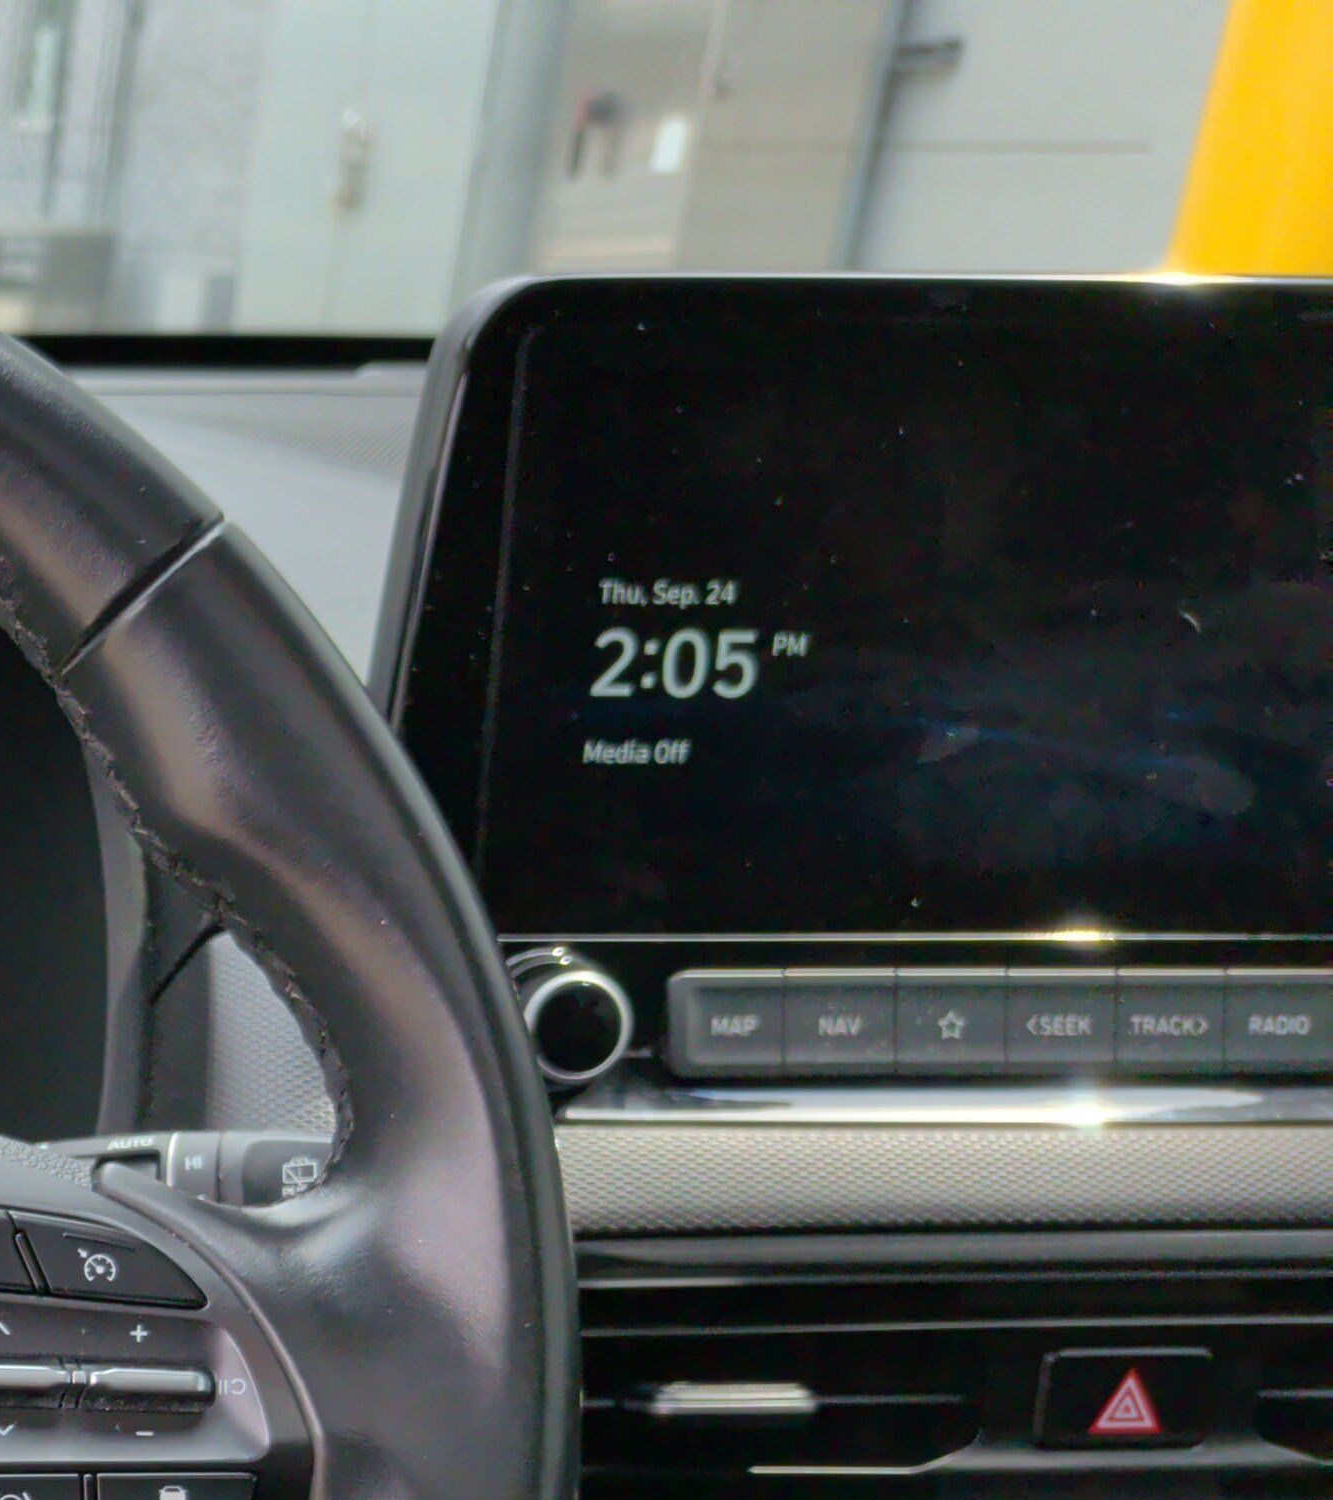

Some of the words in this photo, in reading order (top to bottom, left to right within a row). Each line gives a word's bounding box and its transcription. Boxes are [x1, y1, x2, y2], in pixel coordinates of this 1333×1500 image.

[652, 577, 701, 609] Sep.
[706, 578, 738, 605] 24
[590, 626, 760, 699] 2:05
[772, 632, 810, 657] PM
[583, 738, 651, 765] Media
[653, 738, 692, 765] Off
[710, 1013, 760, 1037] MAP
[818, 1013, 863, 1037] NAV
[1247, 1013, 1312, 1037] RADIO
